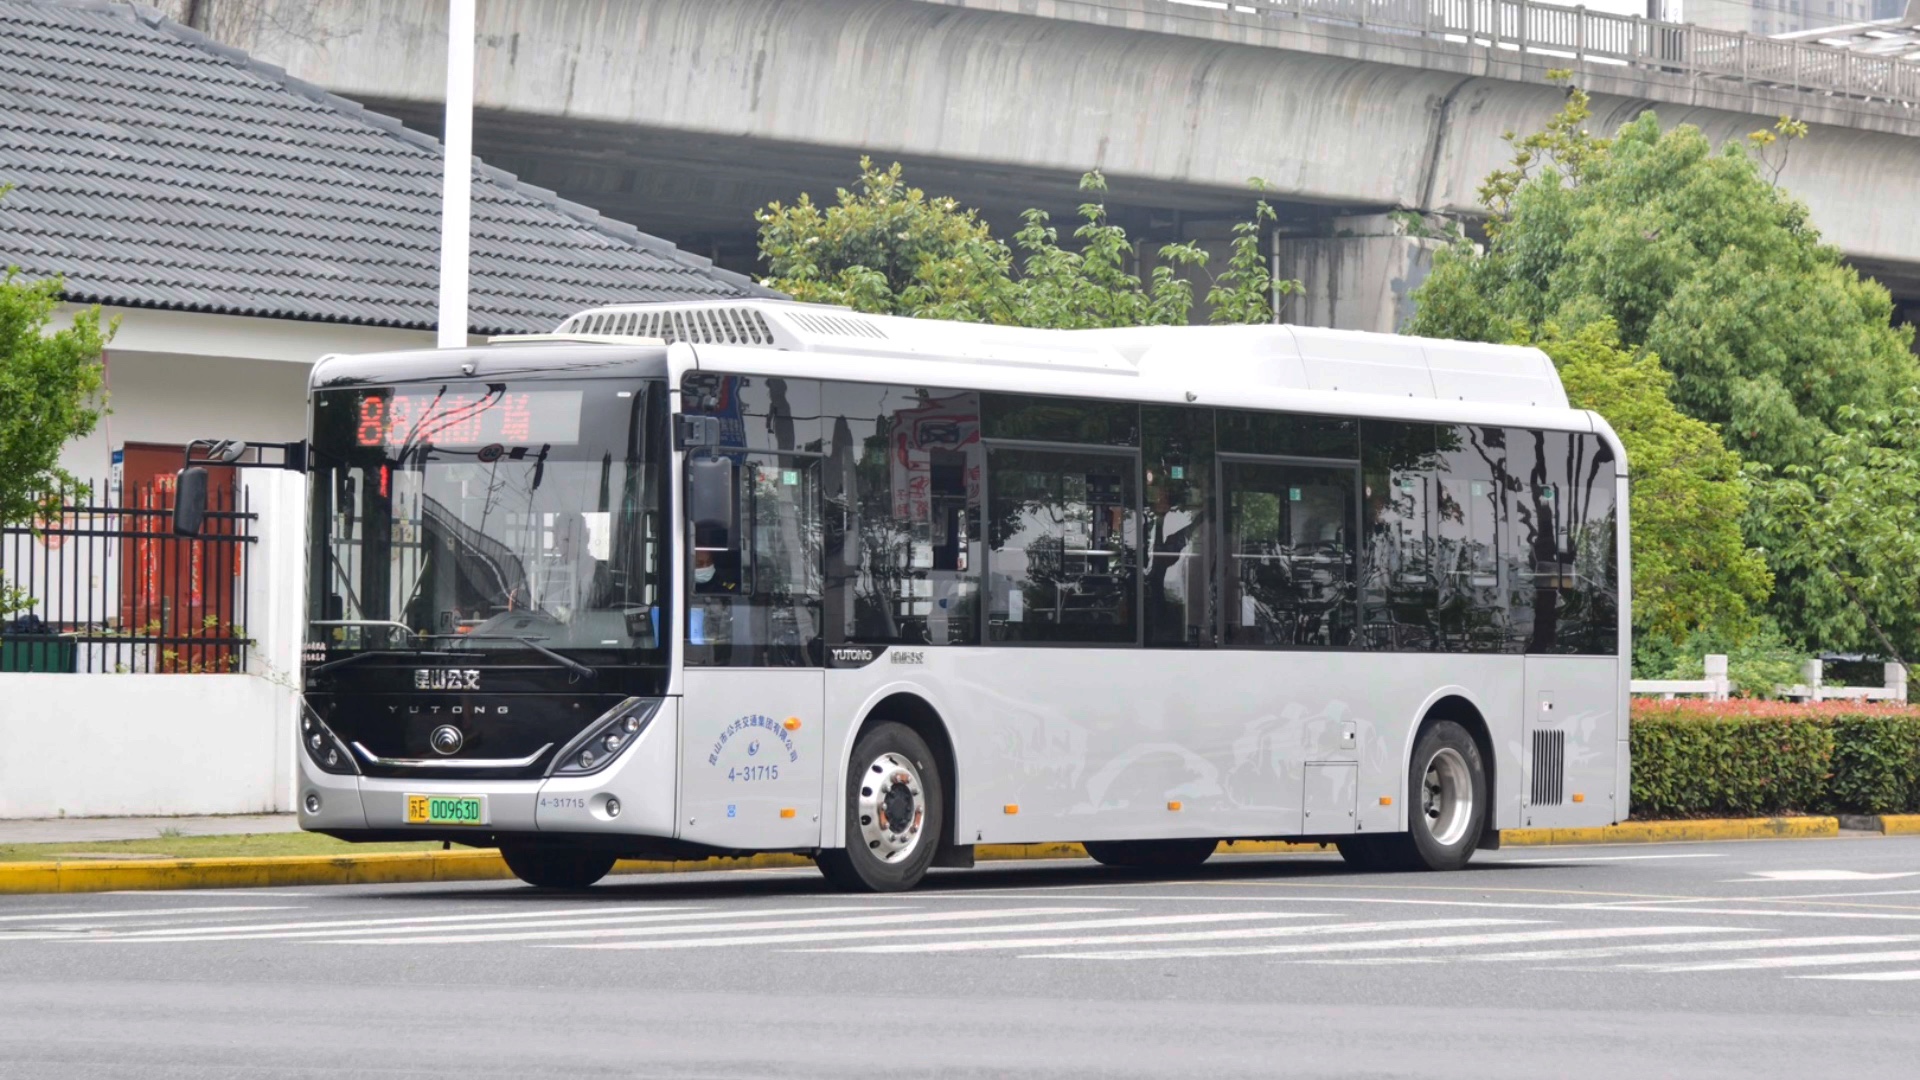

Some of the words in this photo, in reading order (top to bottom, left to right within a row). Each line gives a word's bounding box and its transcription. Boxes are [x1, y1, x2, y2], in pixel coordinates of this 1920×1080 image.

[832, 649, 873, 660] YUTONG
[414, 669, 480, 690] 昆山公交
[389, 706, 509, 714] YUTONG
[708, 714, 798, 766] 昆山市公共交通集团有限公司
[728, 765, 779, 781] 4-31715
[431, 799, 479, 820] 00963D
[540, 798, 584, 807] 4-31715
